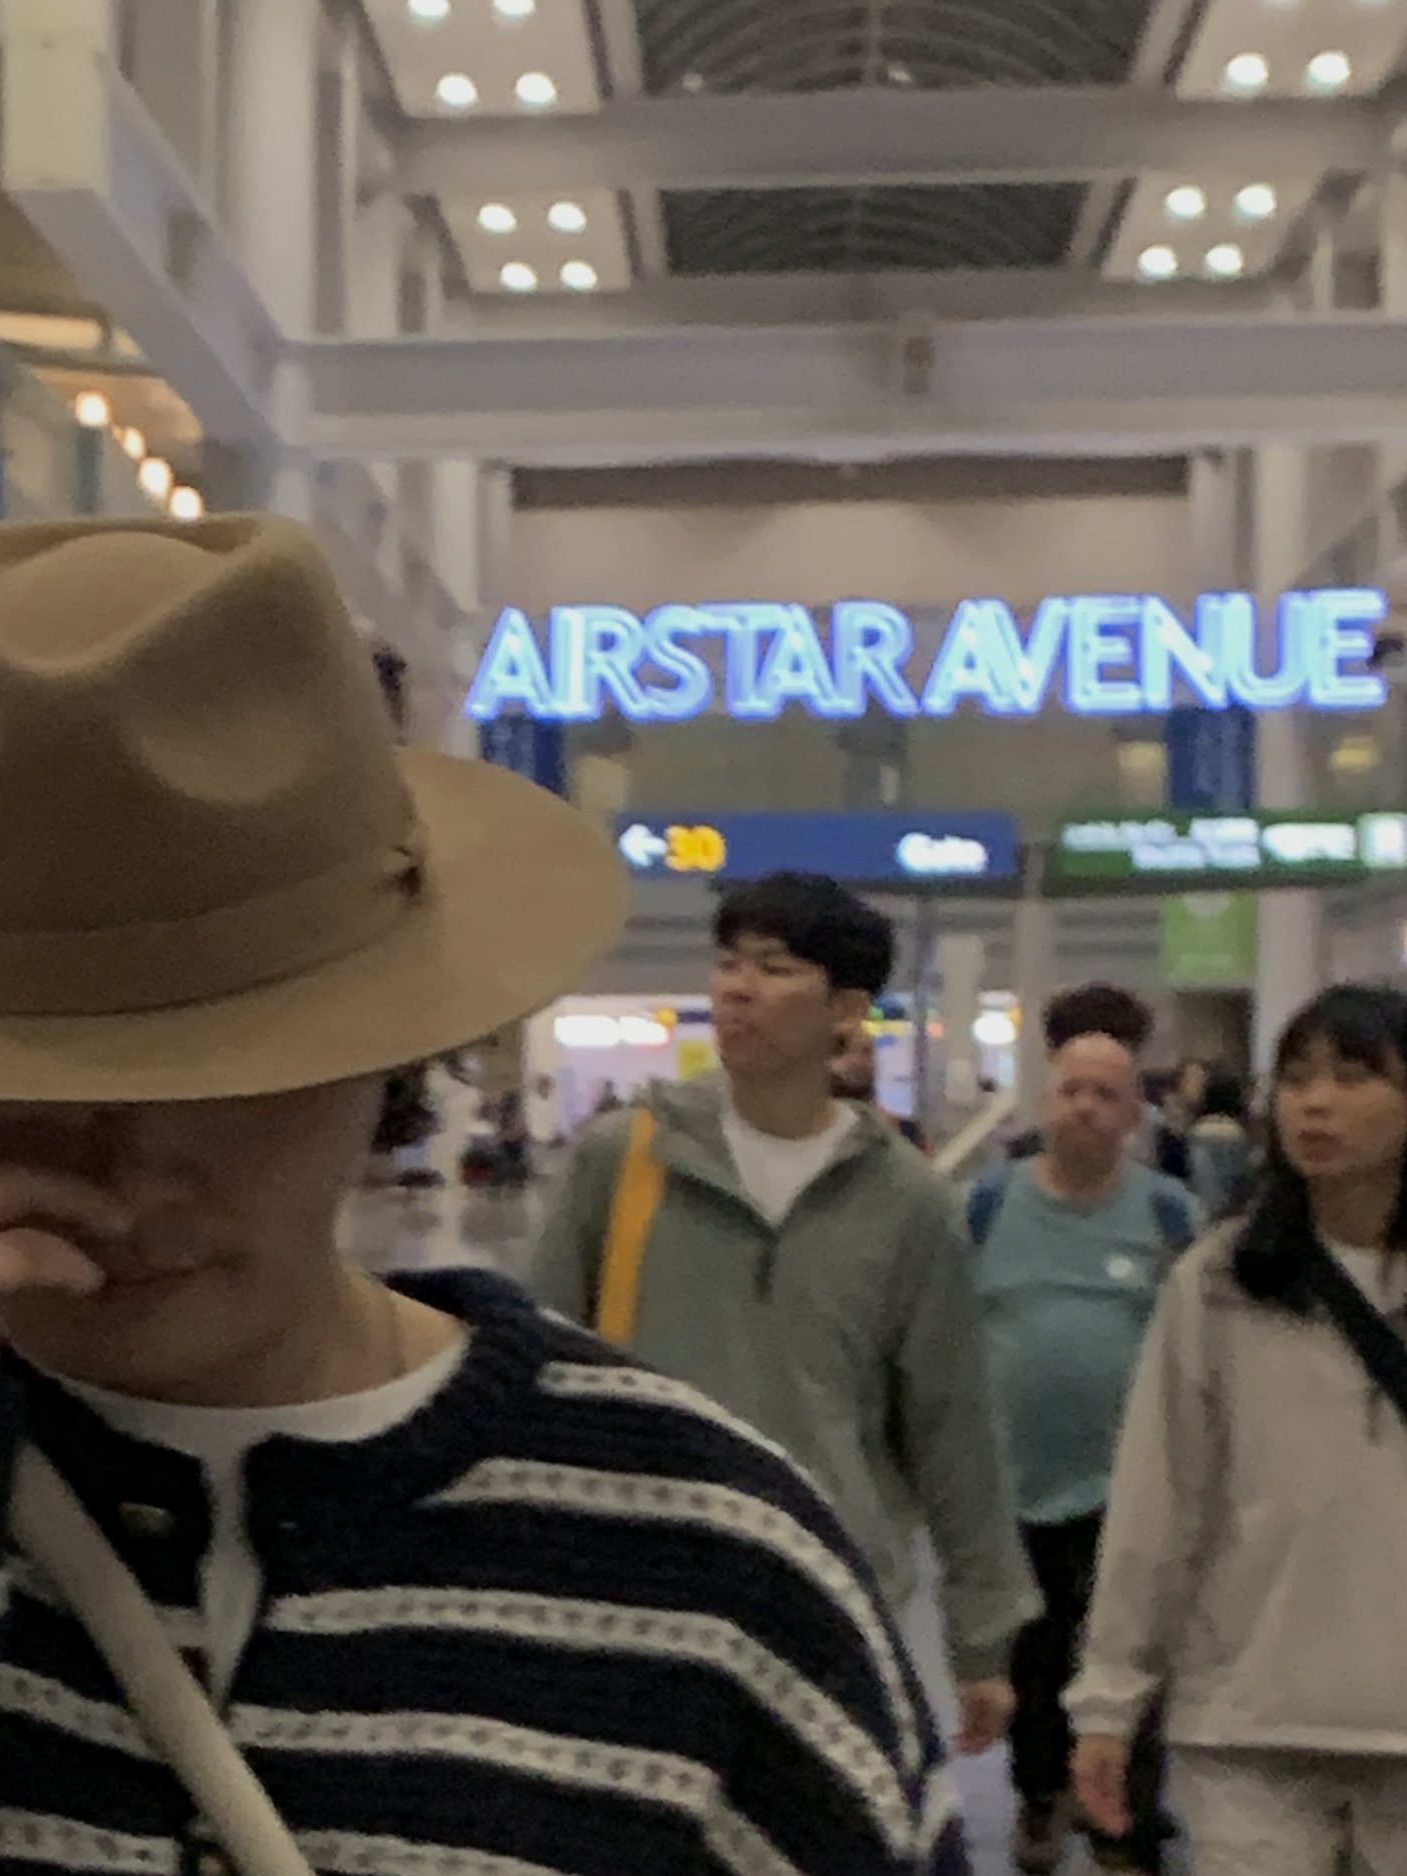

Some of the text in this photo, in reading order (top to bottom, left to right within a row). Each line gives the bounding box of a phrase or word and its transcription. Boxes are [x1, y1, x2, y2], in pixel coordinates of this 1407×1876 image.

[464, 587, 1386, 722] AIRSTAR AVENUE
[665, 824, 727, 873] 30
